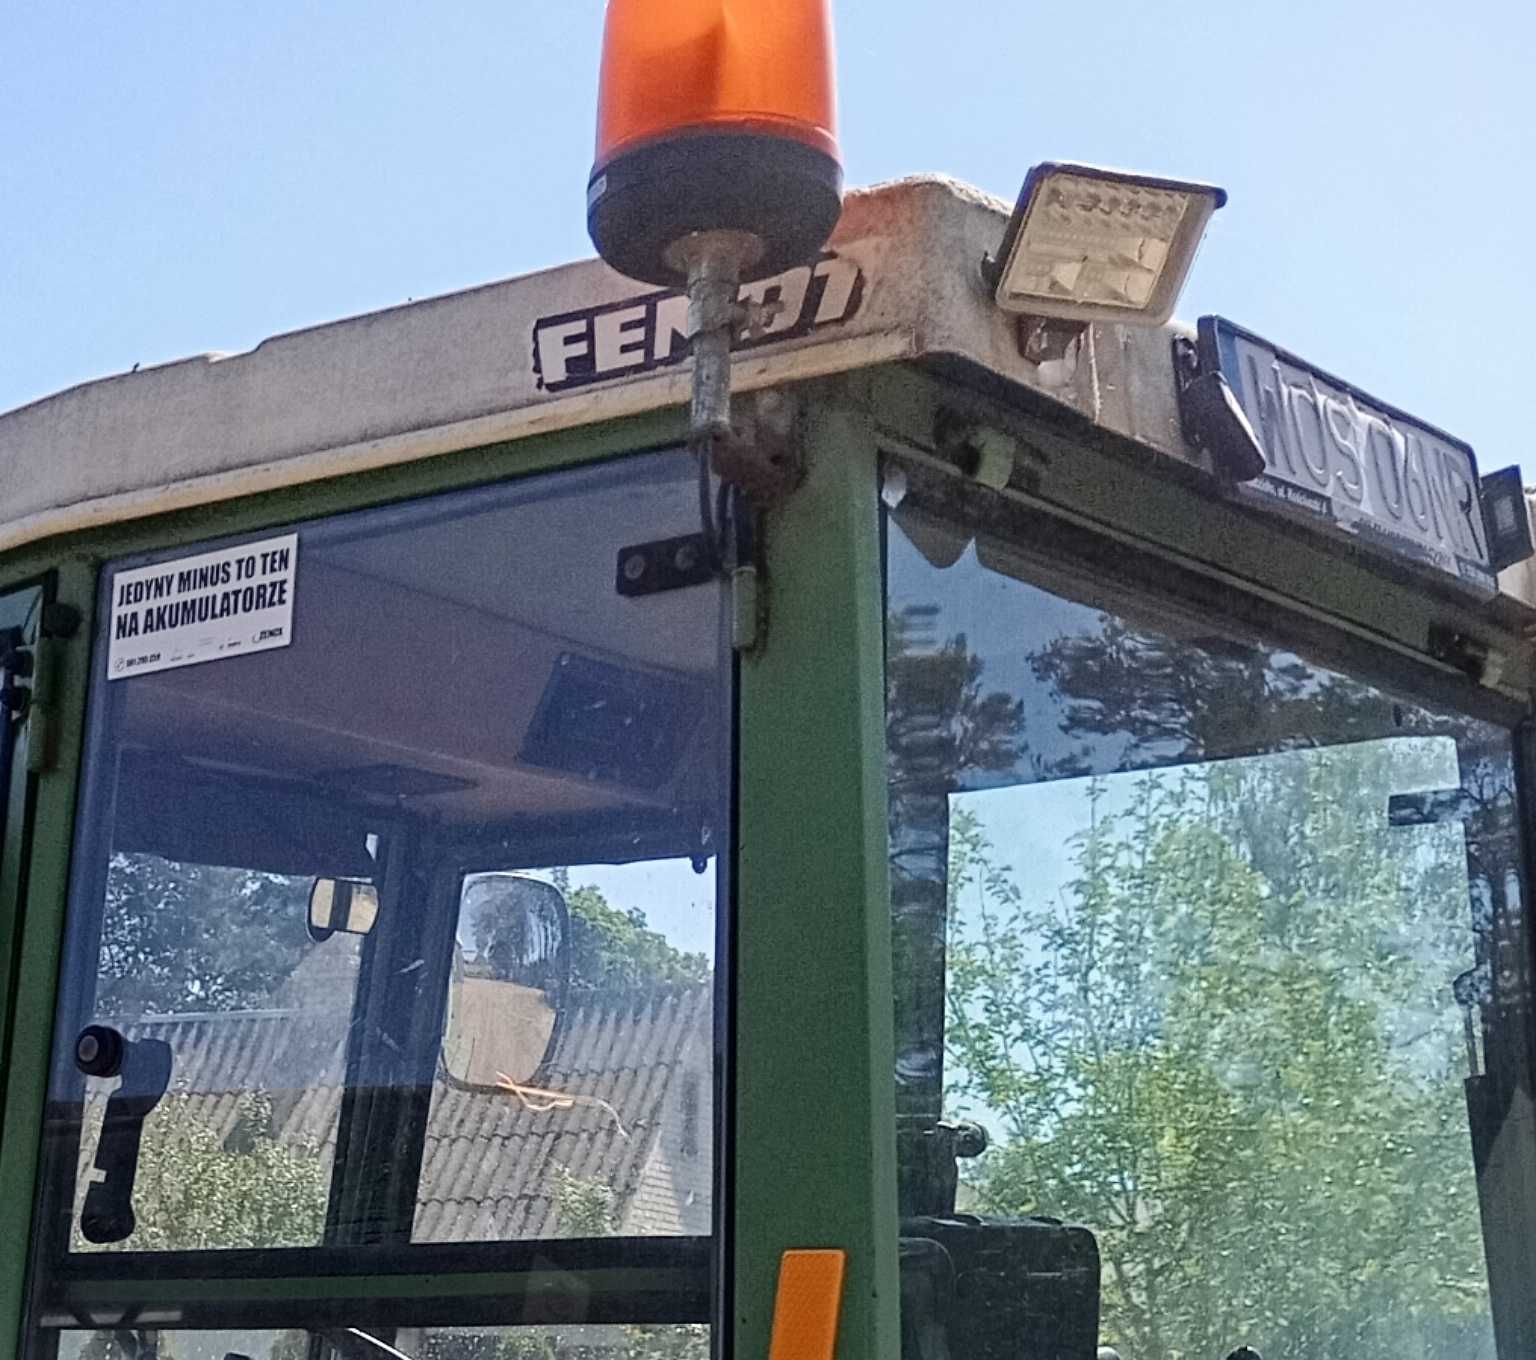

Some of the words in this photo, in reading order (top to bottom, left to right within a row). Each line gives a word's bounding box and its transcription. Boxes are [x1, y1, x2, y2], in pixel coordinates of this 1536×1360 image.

[118, 573, 174, 607] JEDYNY
[177, 560, 231, 593] MINUS
[235, 554, 255, 581] TO
[261, 547, 290, 576] TEN
[115, 610, 139, 640] NA
[142, 578, 287, 633] AKUMULATORZE
